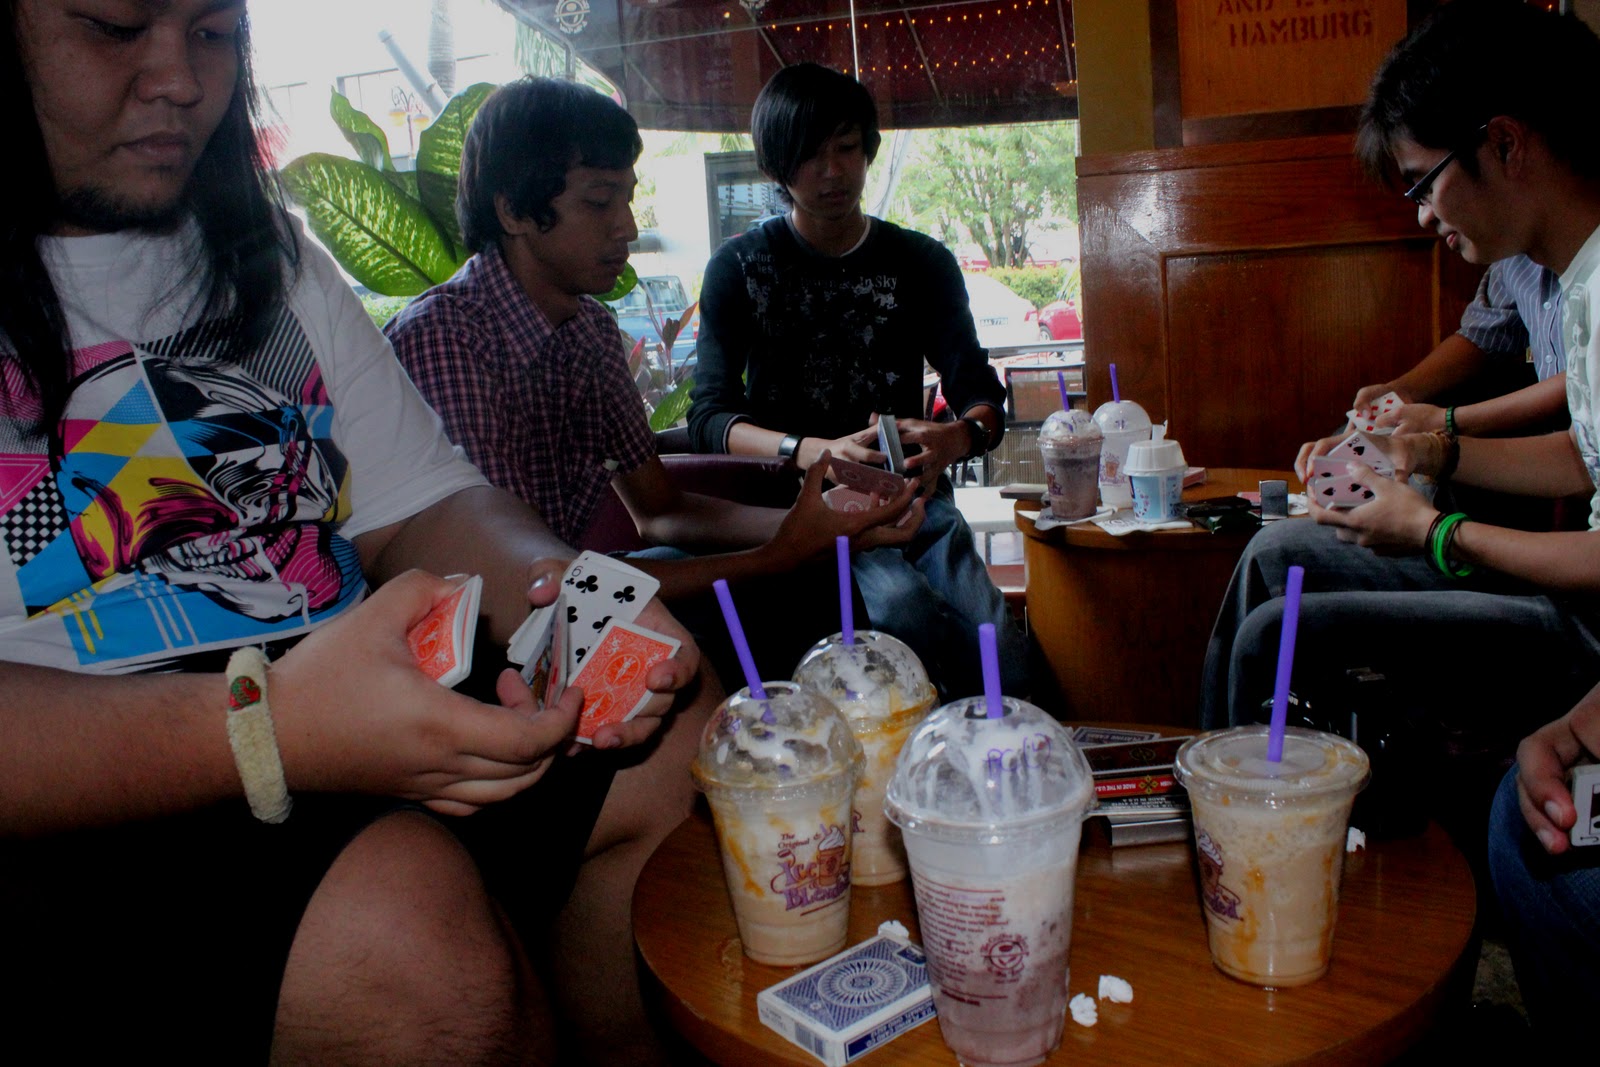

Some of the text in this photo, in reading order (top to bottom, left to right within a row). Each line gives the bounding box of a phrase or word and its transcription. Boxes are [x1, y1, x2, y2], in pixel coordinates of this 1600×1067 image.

[1230, 10, 1372, 47] HAMBURG
[876, 274, 898, 291] Sky
[571, 565, 584, 577] 6
[781, 833, 795, 841] The
[778, 838, 810, 849] Original
